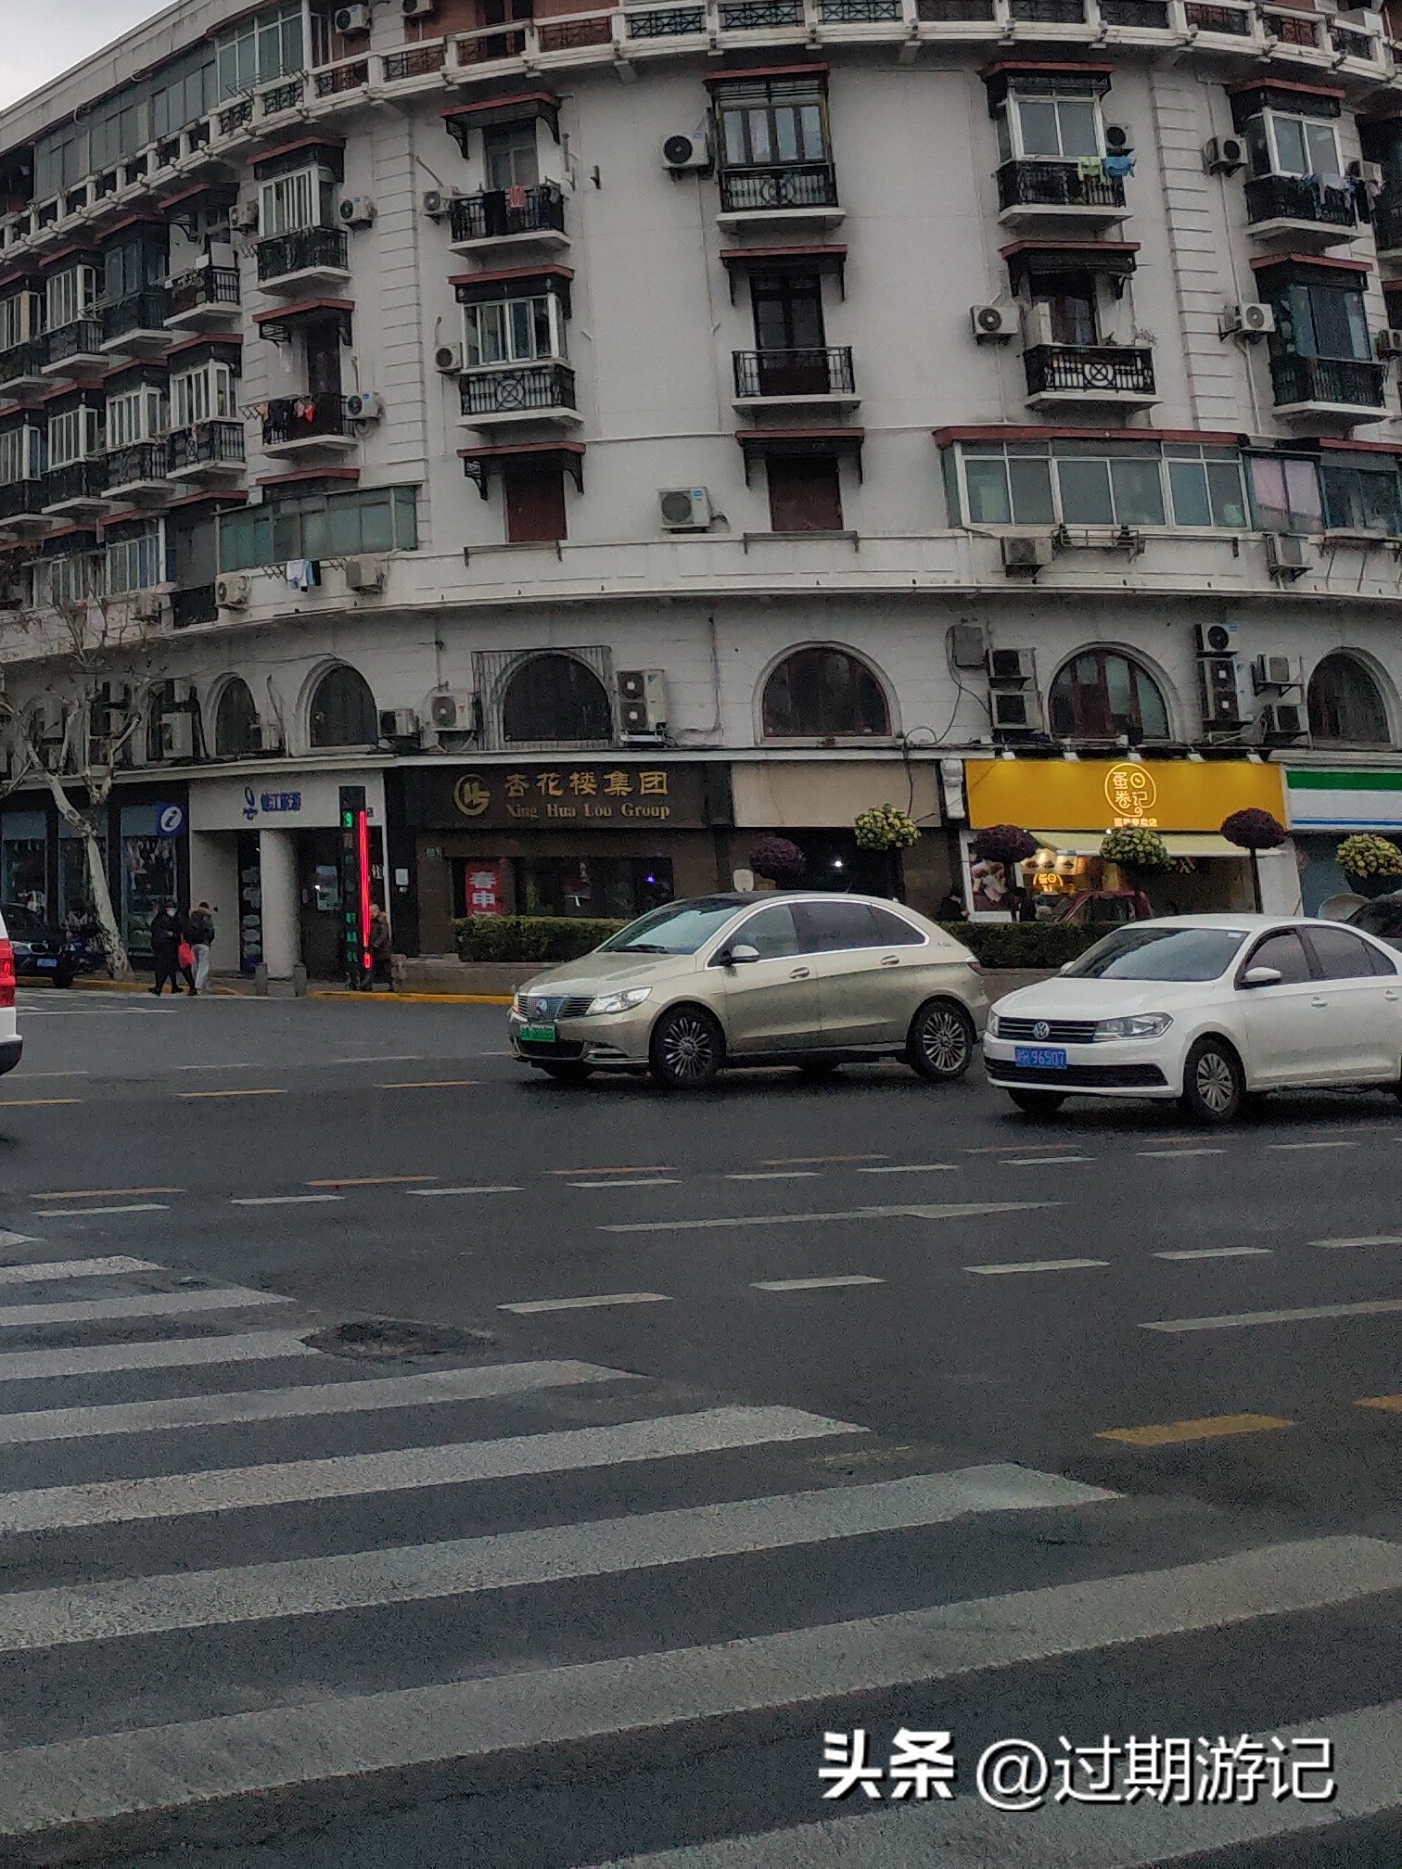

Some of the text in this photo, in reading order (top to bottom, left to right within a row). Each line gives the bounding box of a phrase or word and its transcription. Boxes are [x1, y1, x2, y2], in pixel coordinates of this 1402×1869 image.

[504, 770, 668, 798] 杏花楼集团
[546, 803, 577, 818] Hua
[584, 803, 613, 817] Lou
[621, 802, 671, 820] Group
